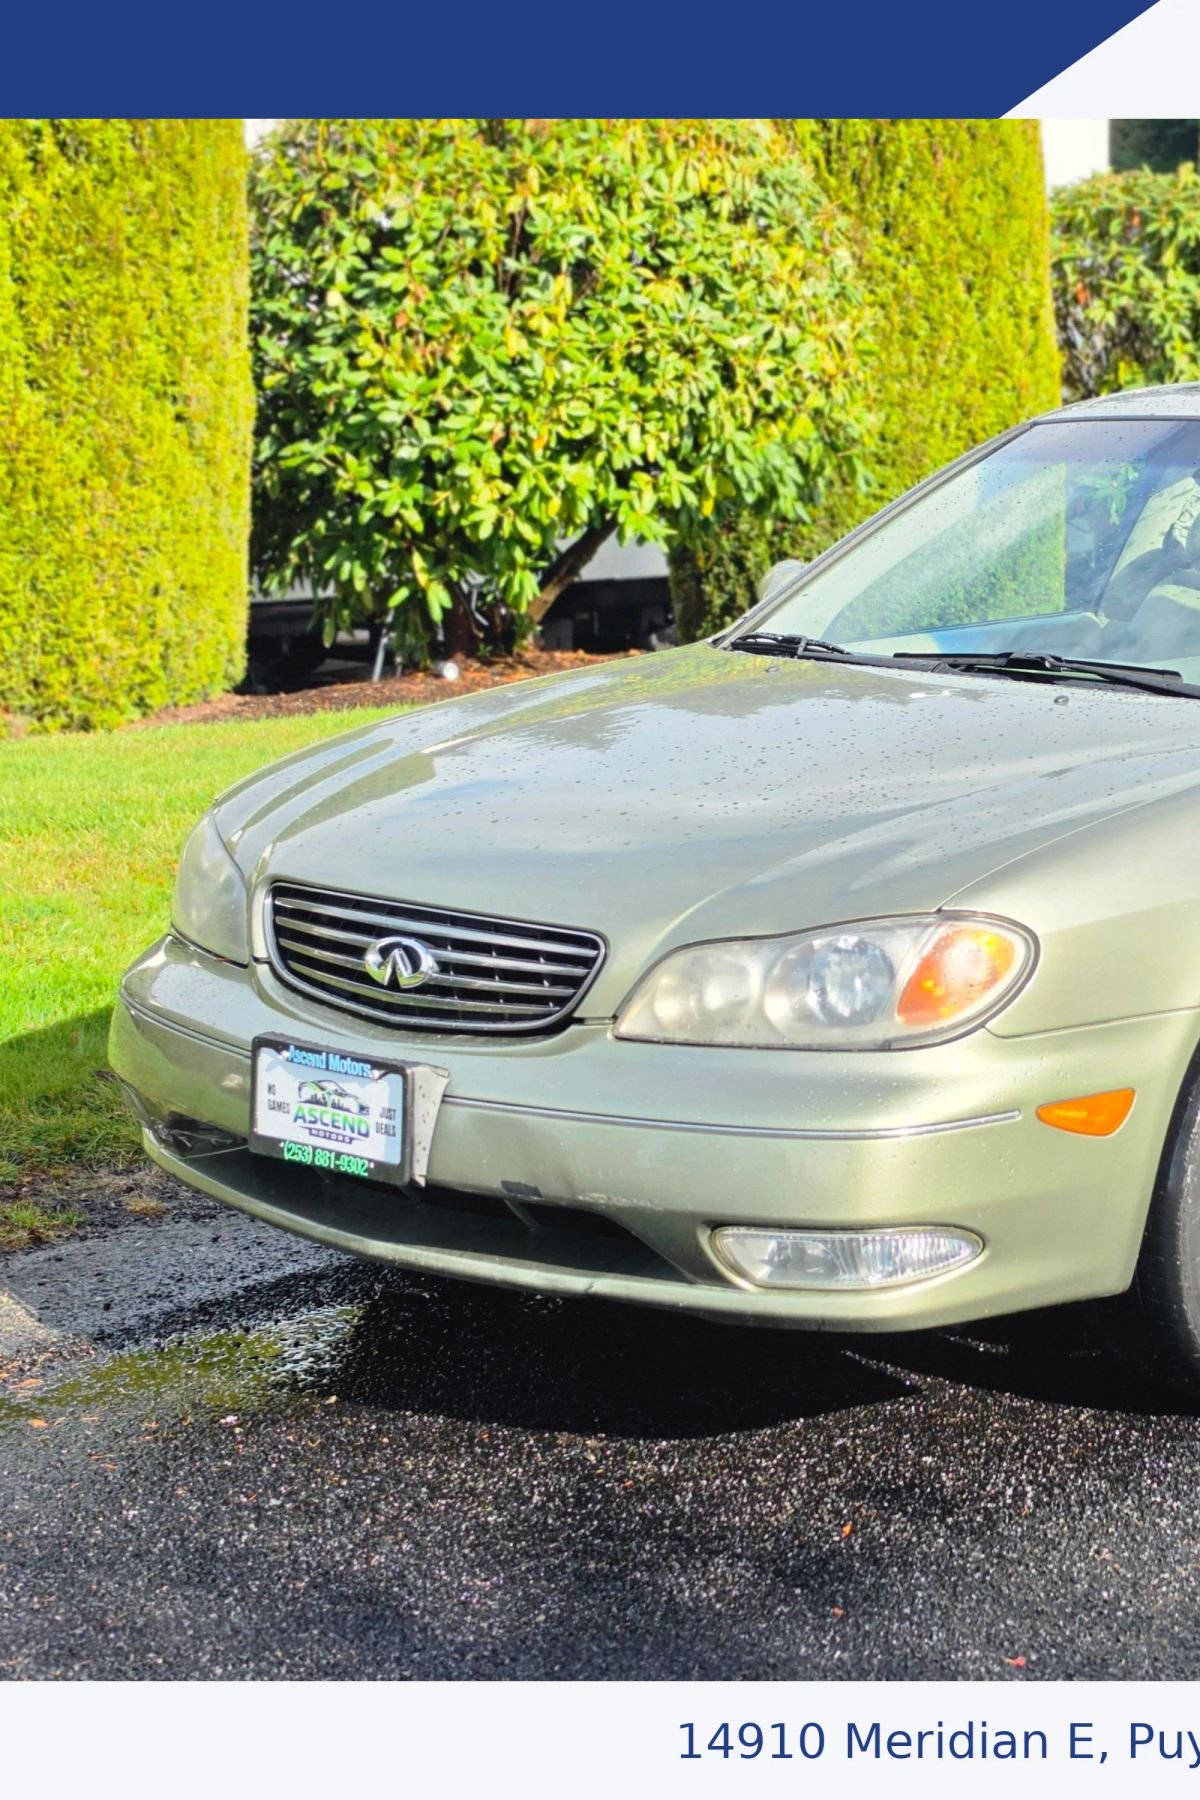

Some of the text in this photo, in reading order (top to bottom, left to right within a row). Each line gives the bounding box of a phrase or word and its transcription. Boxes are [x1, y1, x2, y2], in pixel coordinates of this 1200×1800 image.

[288, 1046, 372, 1077] Ascend Motors
[268, 1099, 290, 1114] GAMES
[380, 1107, 397, 1120] JUST
[293, 1105, 369, 1138] ASCEND
[311, 1129, 351, 1142] MOTORS
[284, 1140, 368, 1176] (253) 881-9302
